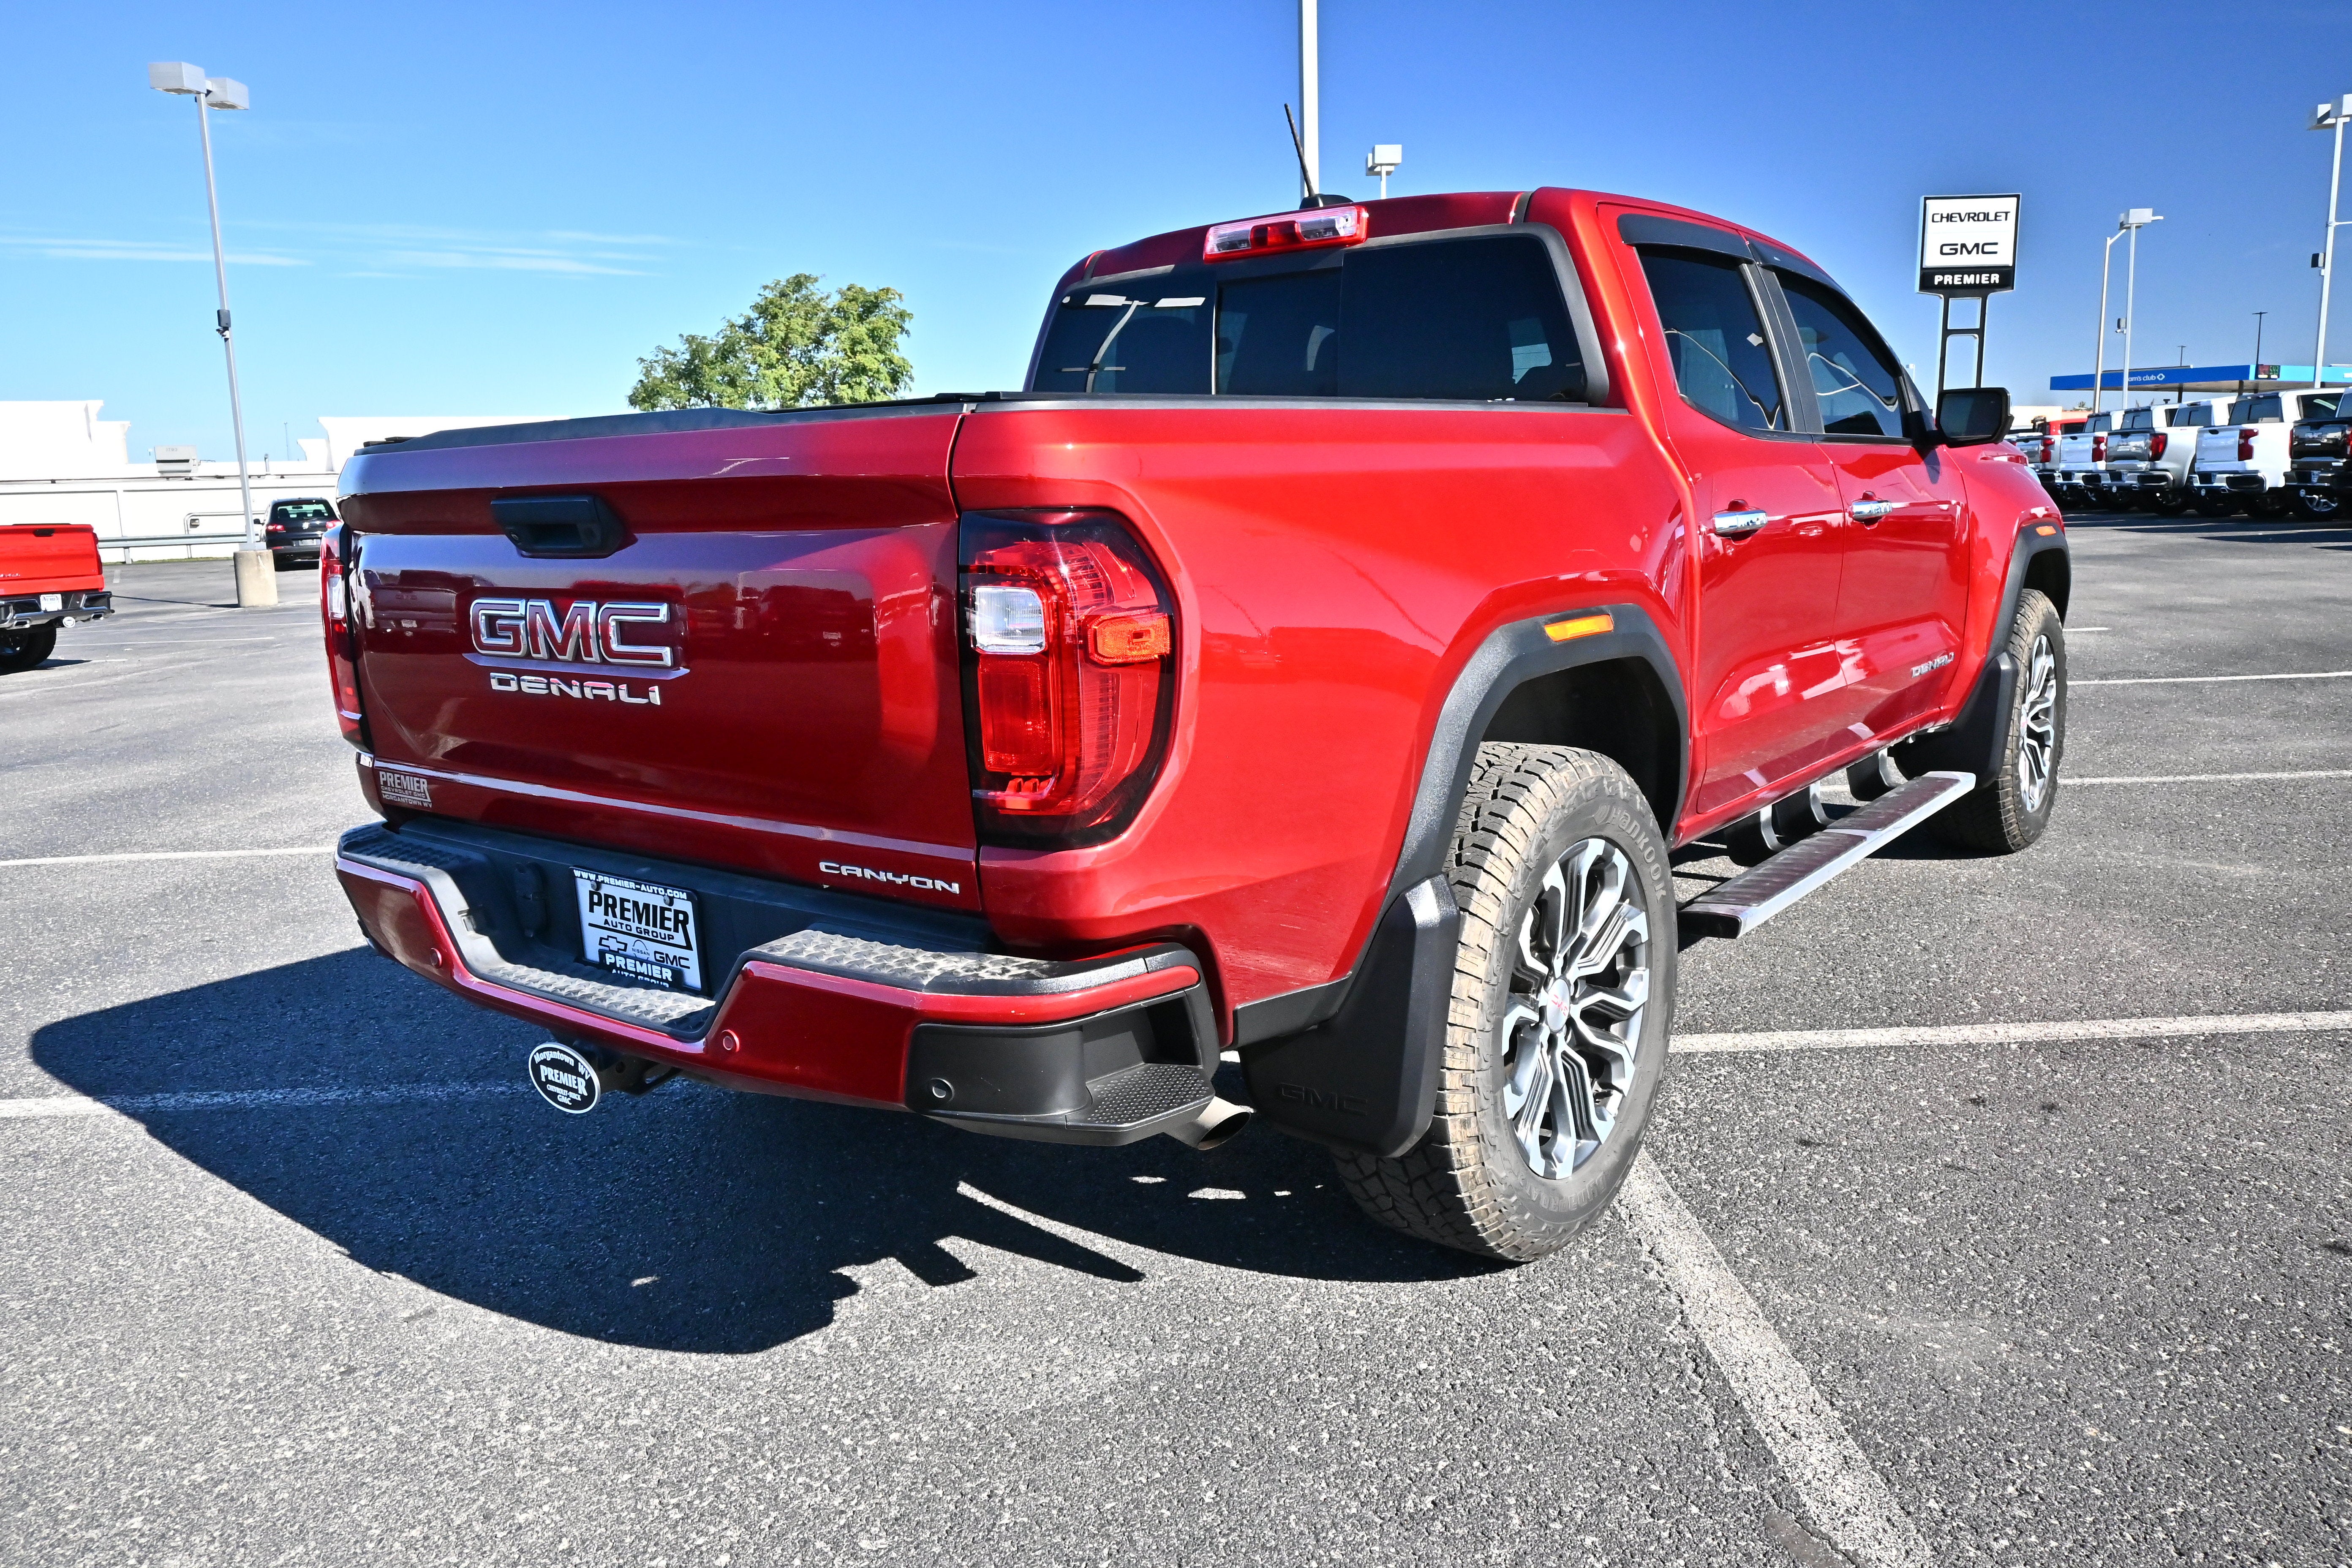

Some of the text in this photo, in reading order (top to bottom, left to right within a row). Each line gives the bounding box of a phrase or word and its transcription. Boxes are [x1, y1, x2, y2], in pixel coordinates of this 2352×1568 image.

[1932, 211, 2010, 223] CHEVROLET
[1940, 242, 1998, 256] GMC
[1934, 273, 2000, 285] PREMIER
[470, 598, 673, 667] GMC
[1911, 652, 1955, 678] DENALI
[490, 672, 661, 705] DENALI
[379, 771, 427, 793] PREMIER
[381, 786, 412, 795] CHEVROLET
[382, 793, 422, 806] MORGANTOWN
[573, 869, 687, 900] WWW.PREMIER-AUTO.COM
[819, 861, 960, 894] CANYON
[589, 890, 689, 934] PREMIER
[604, 919, 675, 941] AUTO GROUP
[632, 948, 650, 956] NISSAN
[654, 950, 690, 969] GMC
[605, 953, 672, 981] PREMIER
[534, 1051, 591, 1080] Morgantown WV
[540, 1064, 588, 1096] PREMIER
[557, 1094, 572, 1105] GMC
[1279, 1082, 1368, 1116] GMC
